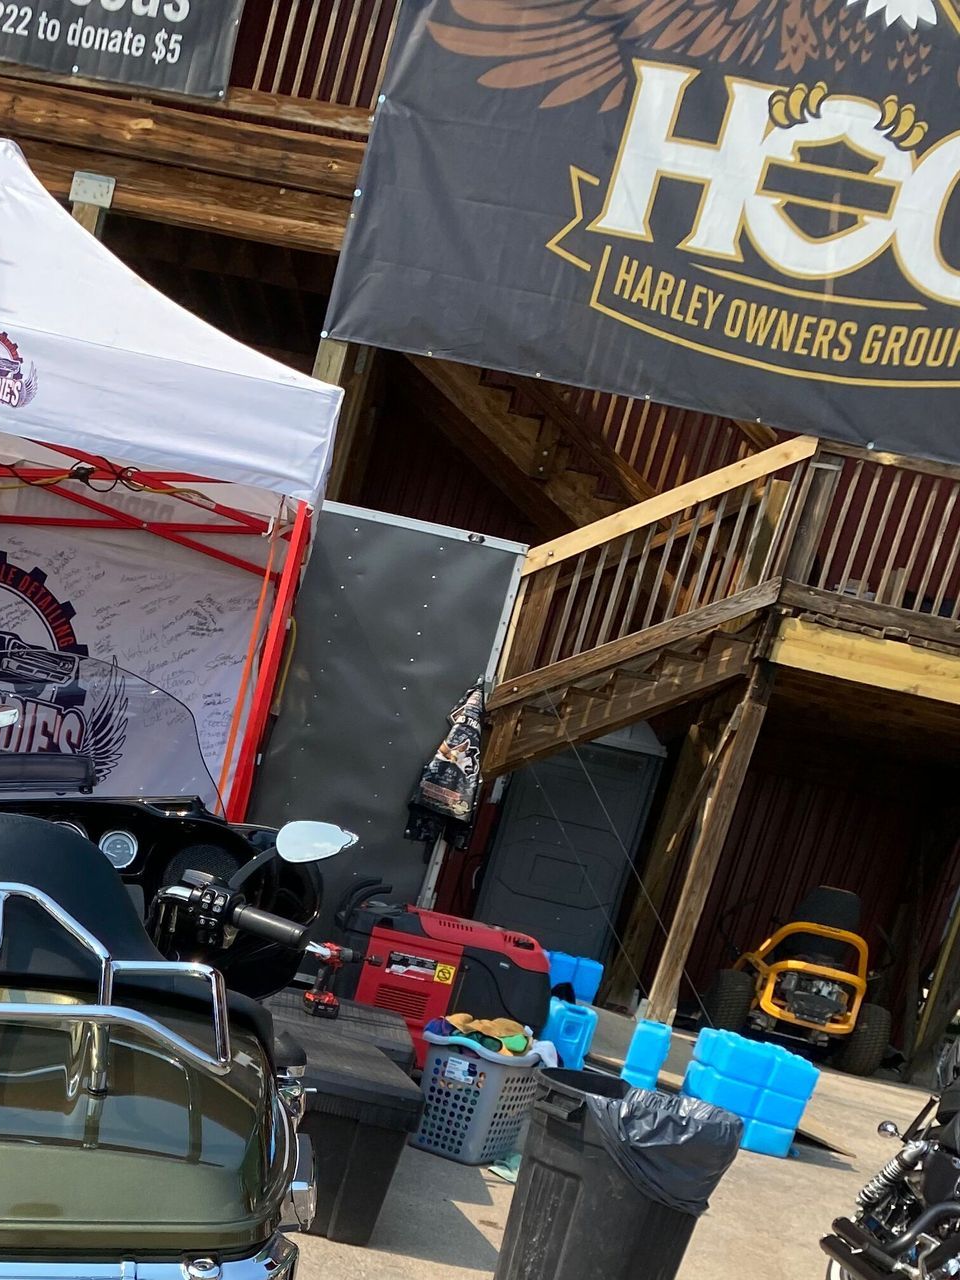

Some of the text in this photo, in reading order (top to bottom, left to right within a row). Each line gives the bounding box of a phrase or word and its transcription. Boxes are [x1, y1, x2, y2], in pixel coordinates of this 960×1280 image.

[38, 11, 61, 42] to
[67, 18, 146, 57] donate
[152, 28, 183, 64] $5
[613, 255, 725, 330] HARLEY
[724, 298, 858, 362] OWNERS
[18, 575, 75, 648] DETAILING
